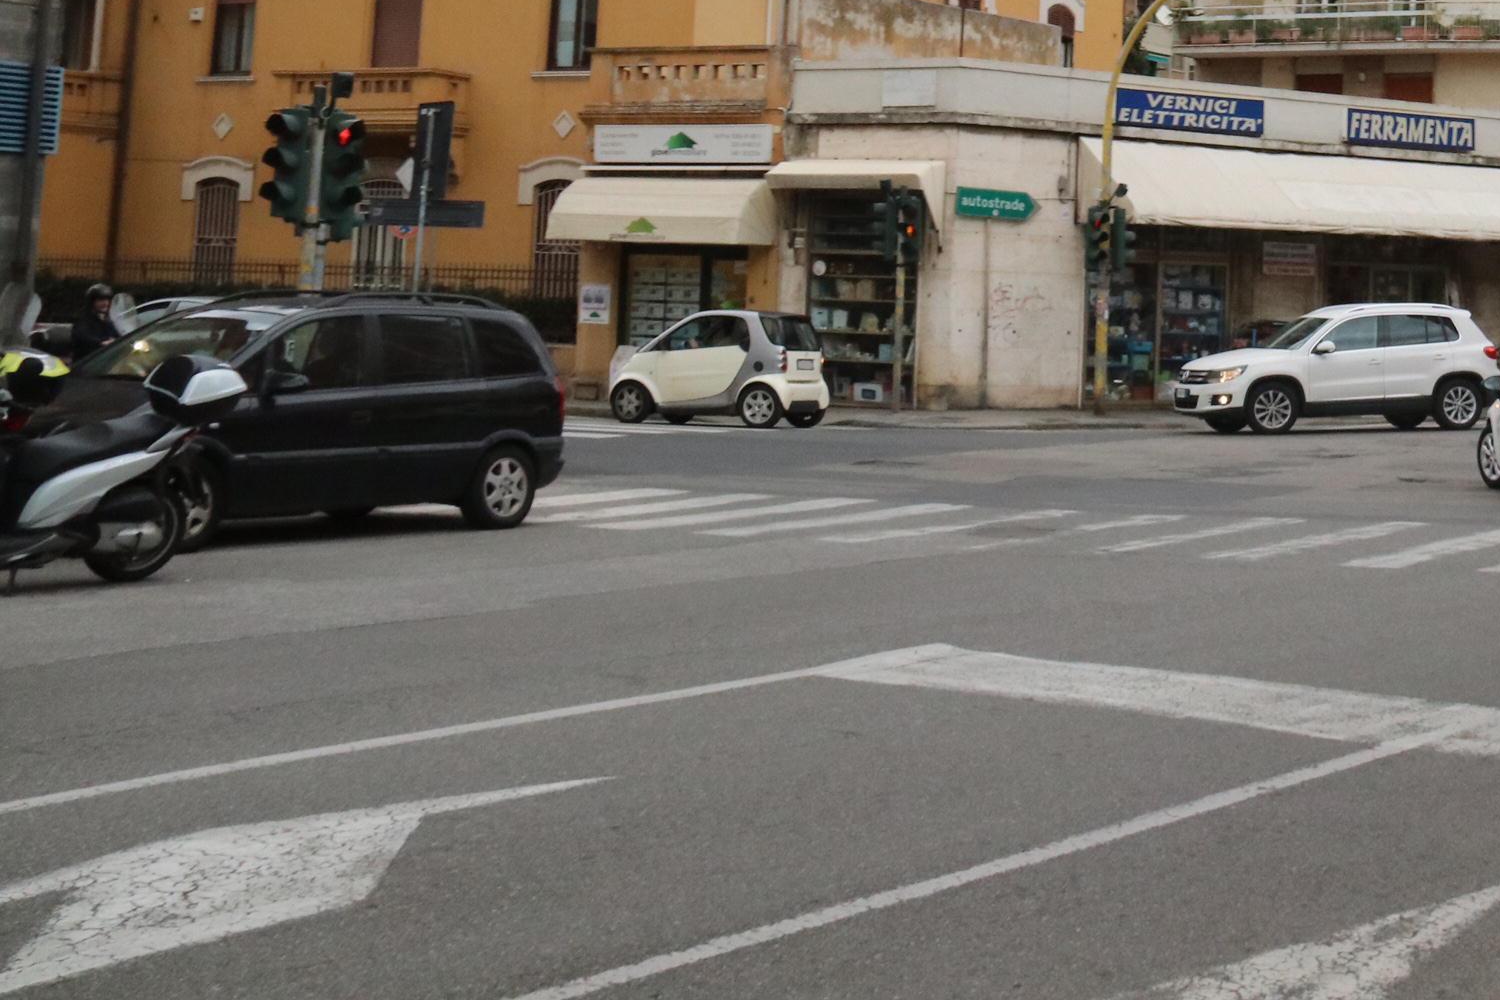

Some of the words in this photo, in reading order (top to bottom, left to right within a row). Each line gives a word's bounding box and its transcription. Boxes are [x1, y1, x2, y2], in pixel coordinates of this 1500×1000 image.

[1145, 93, 1238, 115] VERNICI
[1117, 107, 1263, 132] ELETTRICITA'
[1349, 112, 1474, 148] FERRAMENTA
[960, 195, 1026, 212] autostrade
